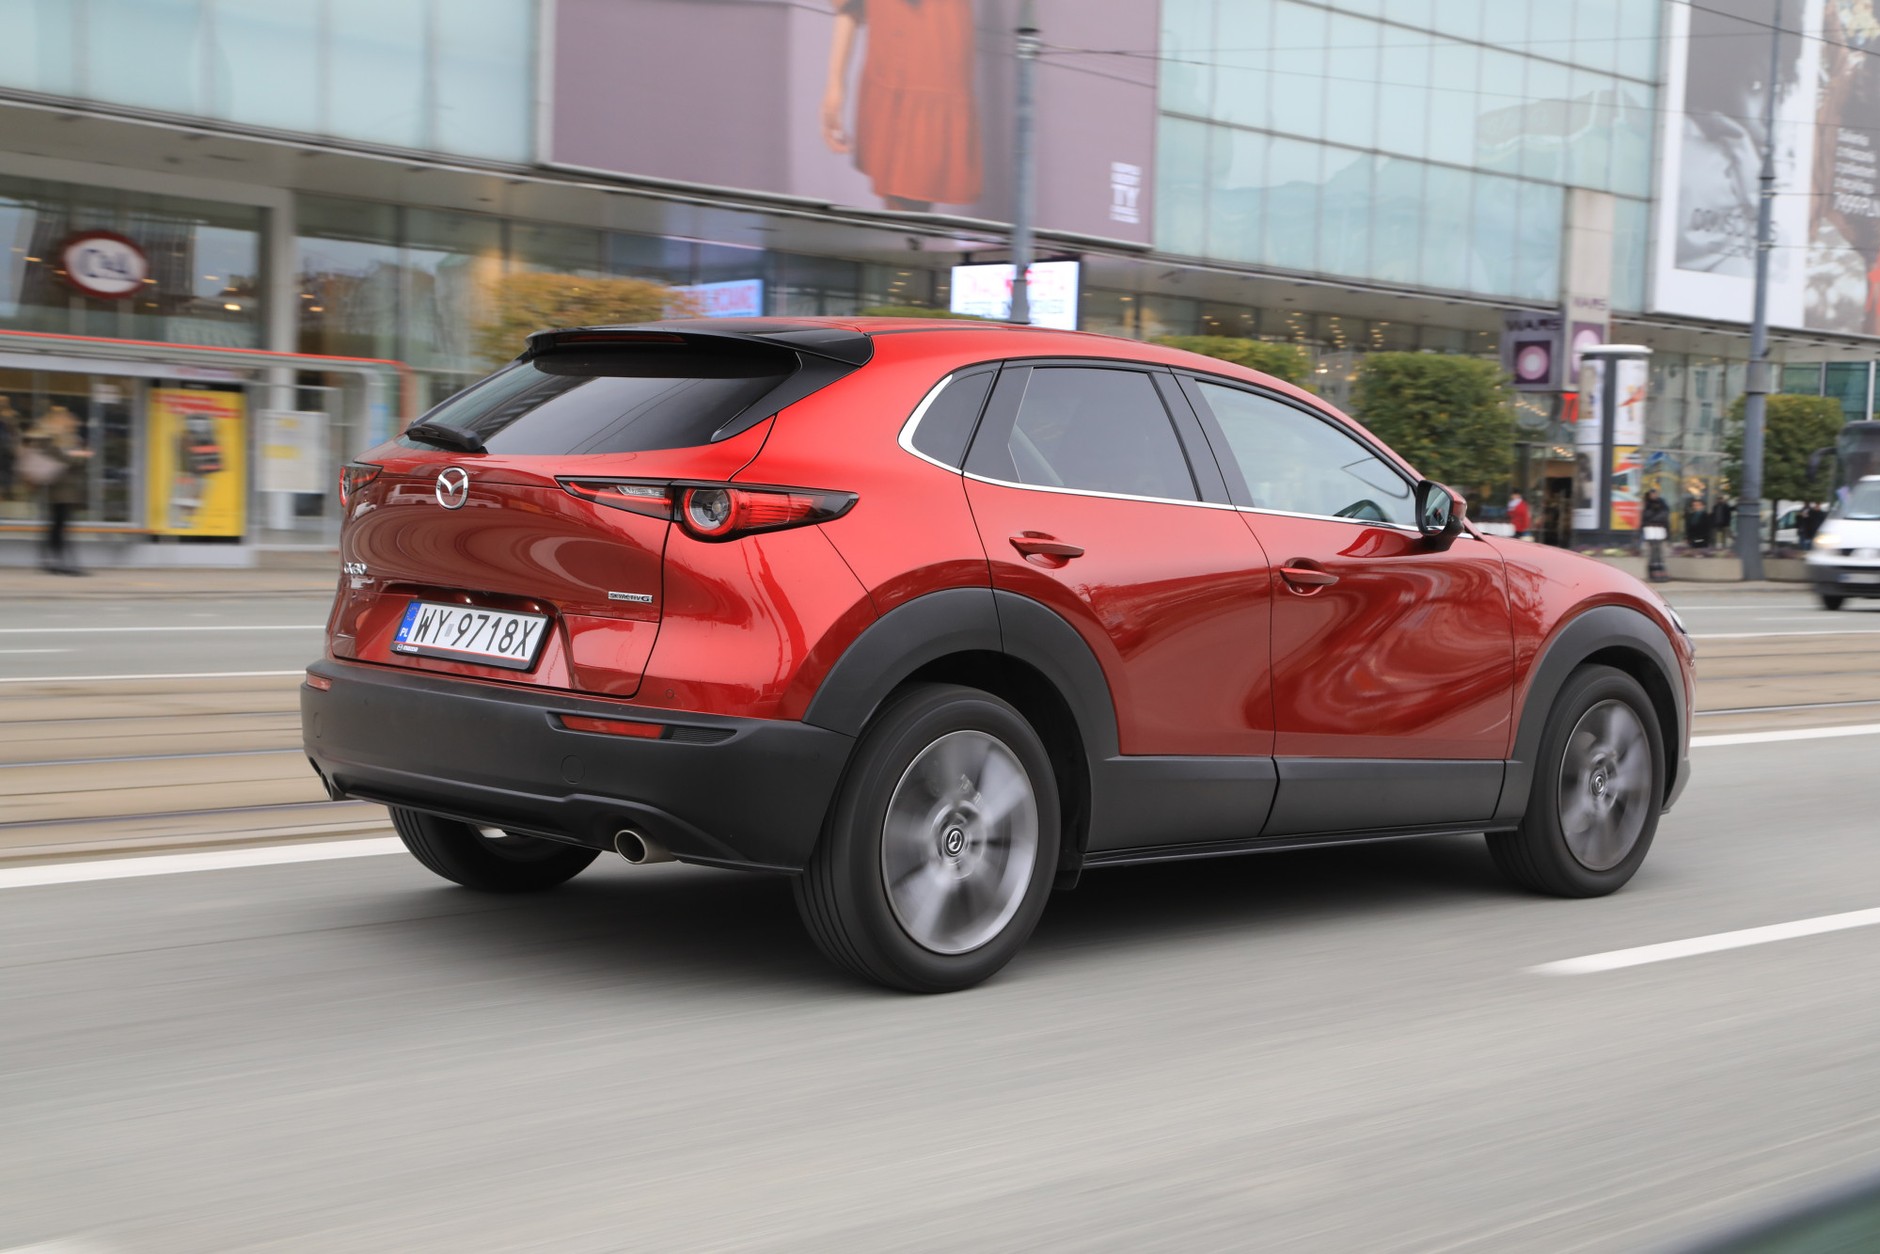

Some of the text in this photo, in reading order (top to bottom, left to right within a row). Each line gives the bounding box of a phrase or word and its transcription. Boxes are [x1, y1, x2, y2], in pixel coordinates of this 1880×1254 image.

[399, 626, 409, 638] PL
[413, 608, 538, 657] WY 9718X
